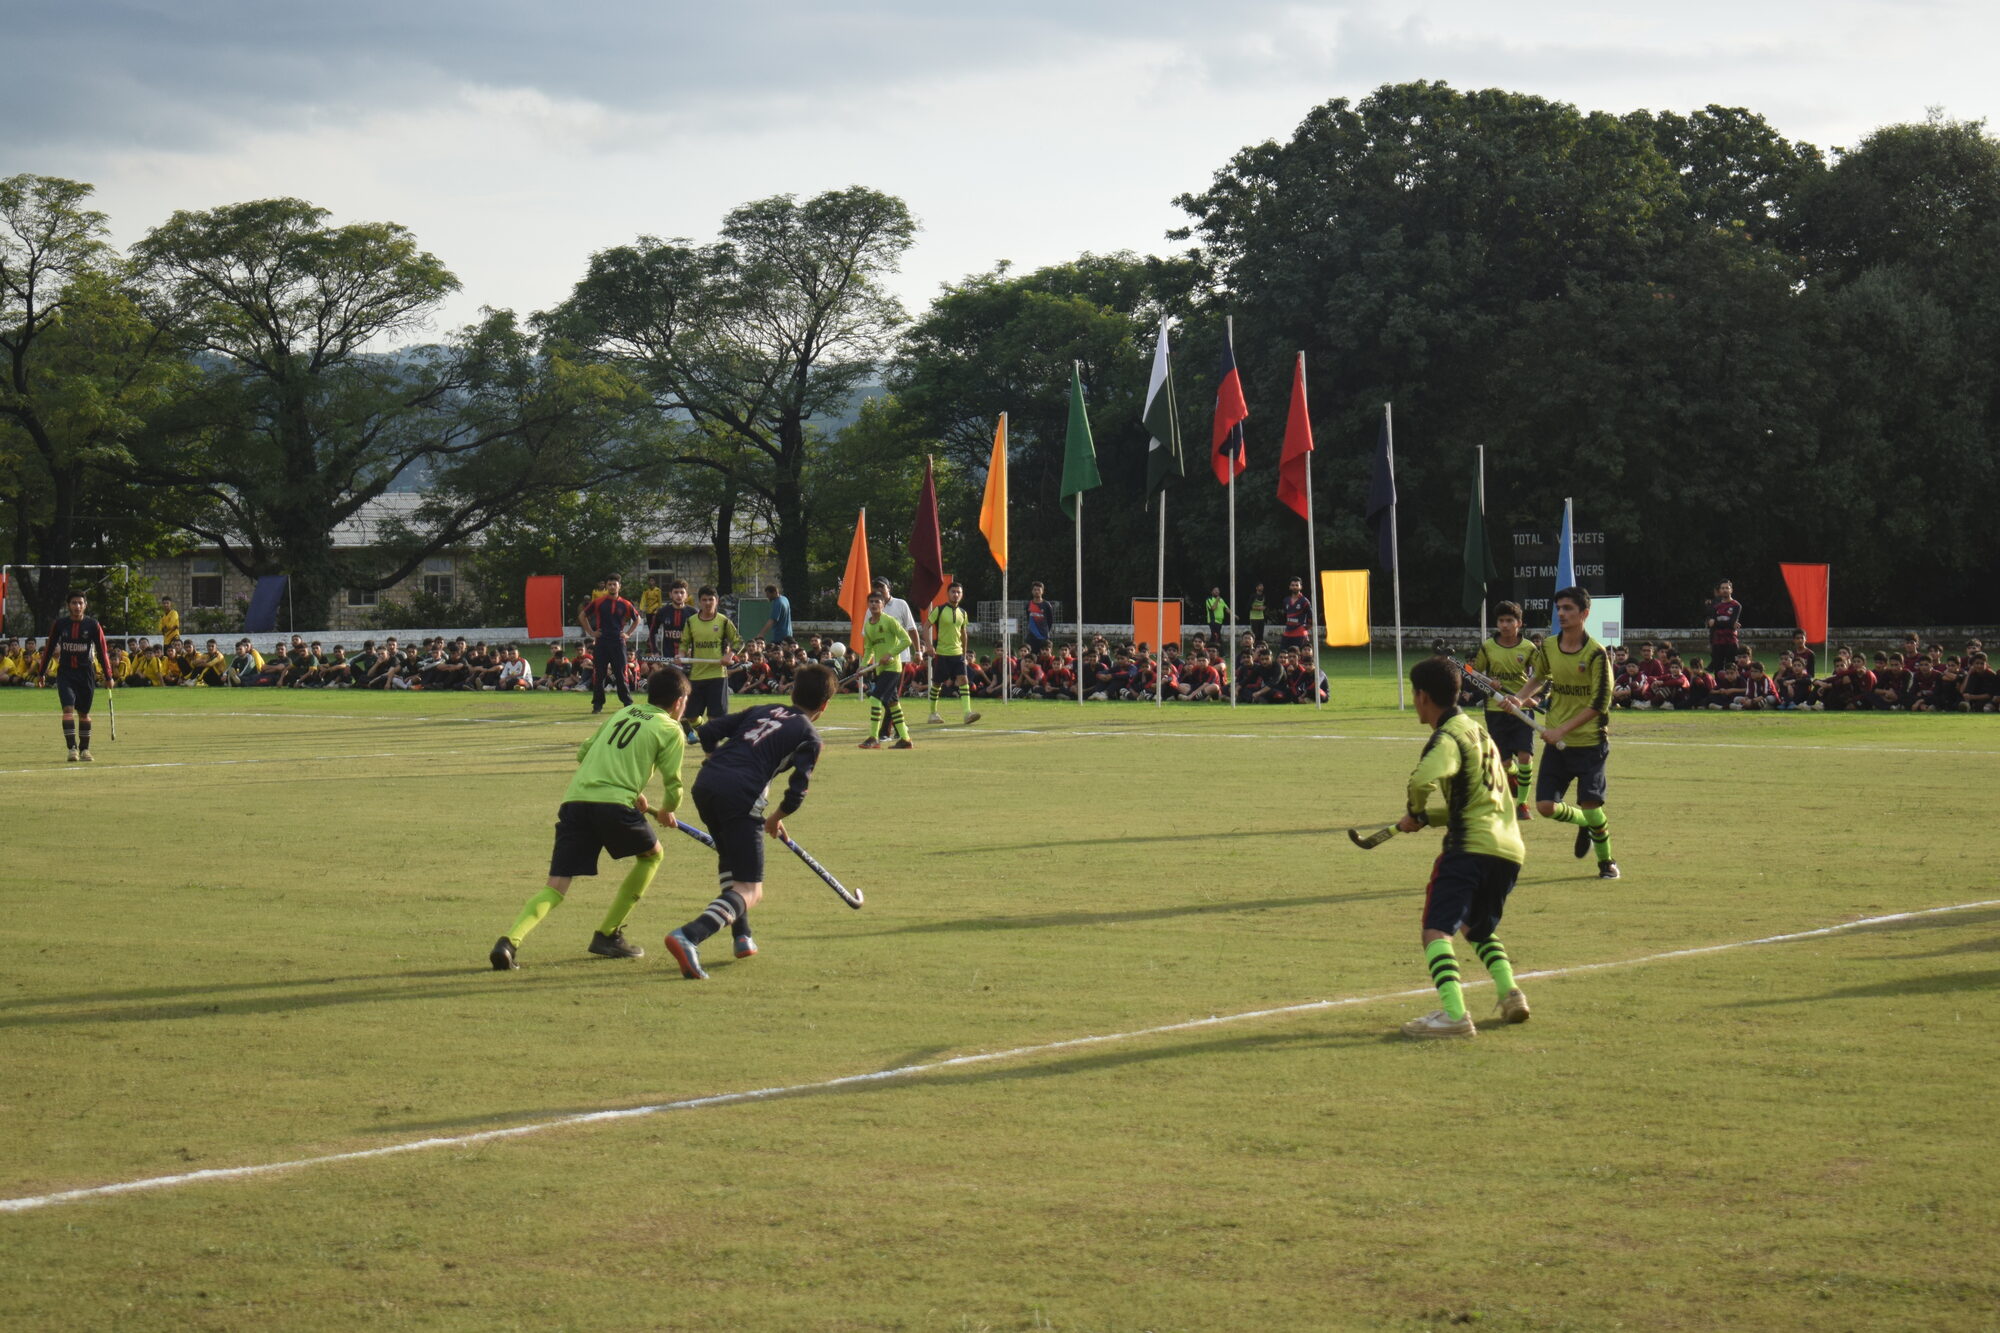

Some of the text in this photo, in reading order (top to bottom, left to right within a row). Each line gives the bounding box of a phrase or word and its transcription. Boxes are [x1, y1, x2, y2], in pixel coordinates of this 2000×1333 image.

[1513, 533, 1604, 545] TOTAL WCKETS
[1513, 566, 1537, 578] LAST
[1575, 564, 1604, 576] OVERS
[1524, 598, 1549, 610] FIRST
[607, 717, 642, 749] 10
